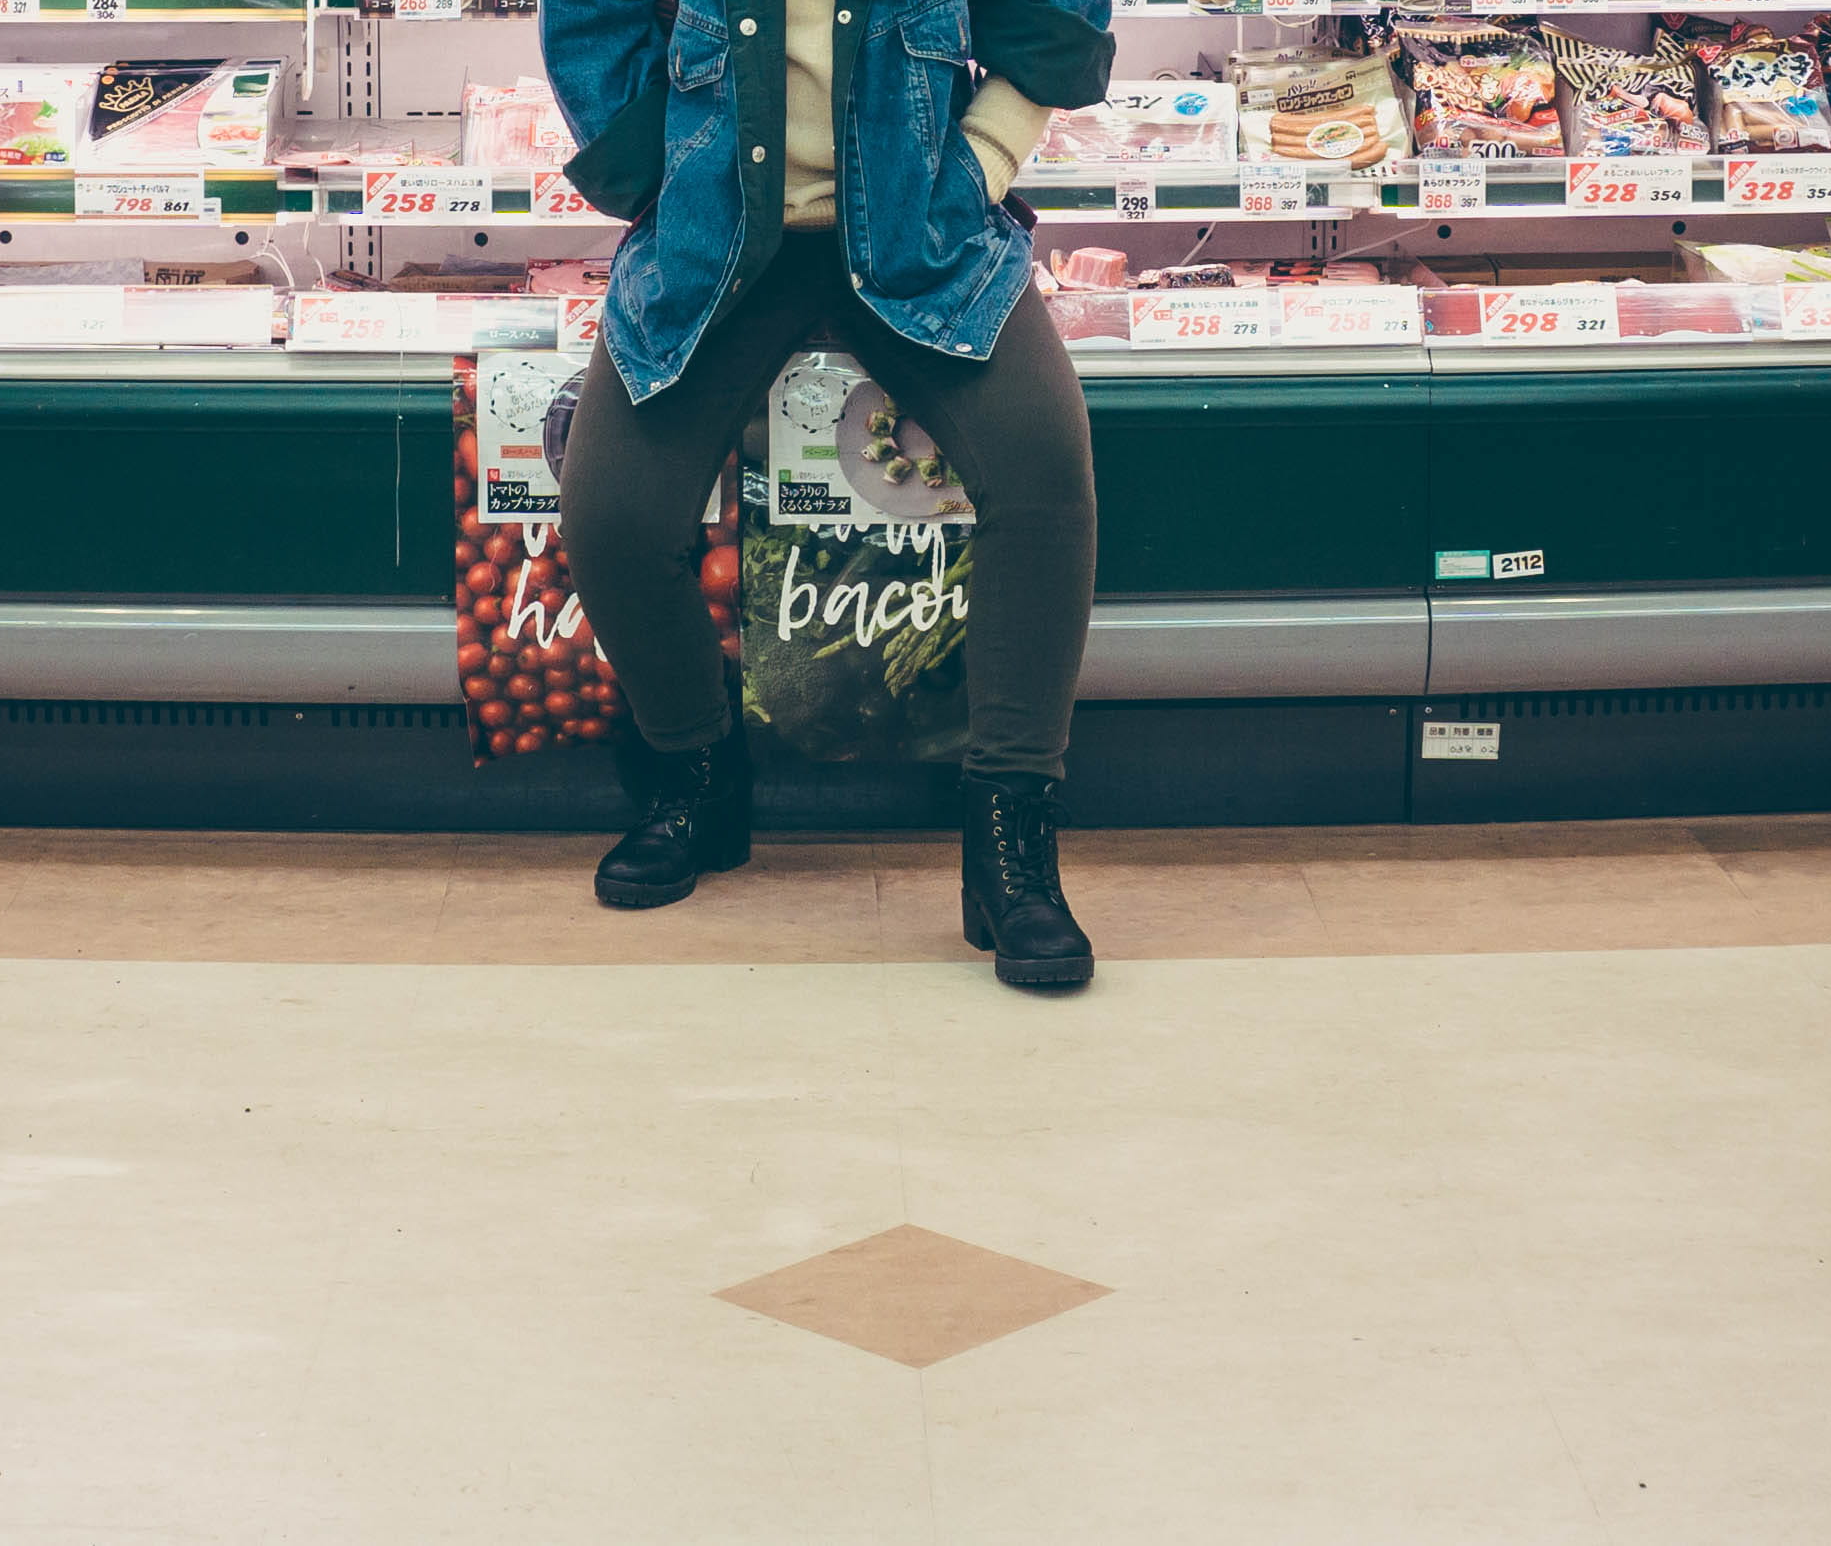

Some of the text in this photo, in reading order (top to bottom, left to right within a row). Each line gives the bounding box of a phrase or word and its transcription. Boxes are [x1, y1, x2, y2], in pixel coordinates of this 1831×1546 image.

[1583, 182, 1682, 203] 328 354
[113, 196, 153, 212] 798
[381, 193, 481, 213] 258 278
[1243, 195, 1273, 211] 368
[1501, 312, 1606, 333] 298 321
[1501, 555, 1542, 573] 2112
